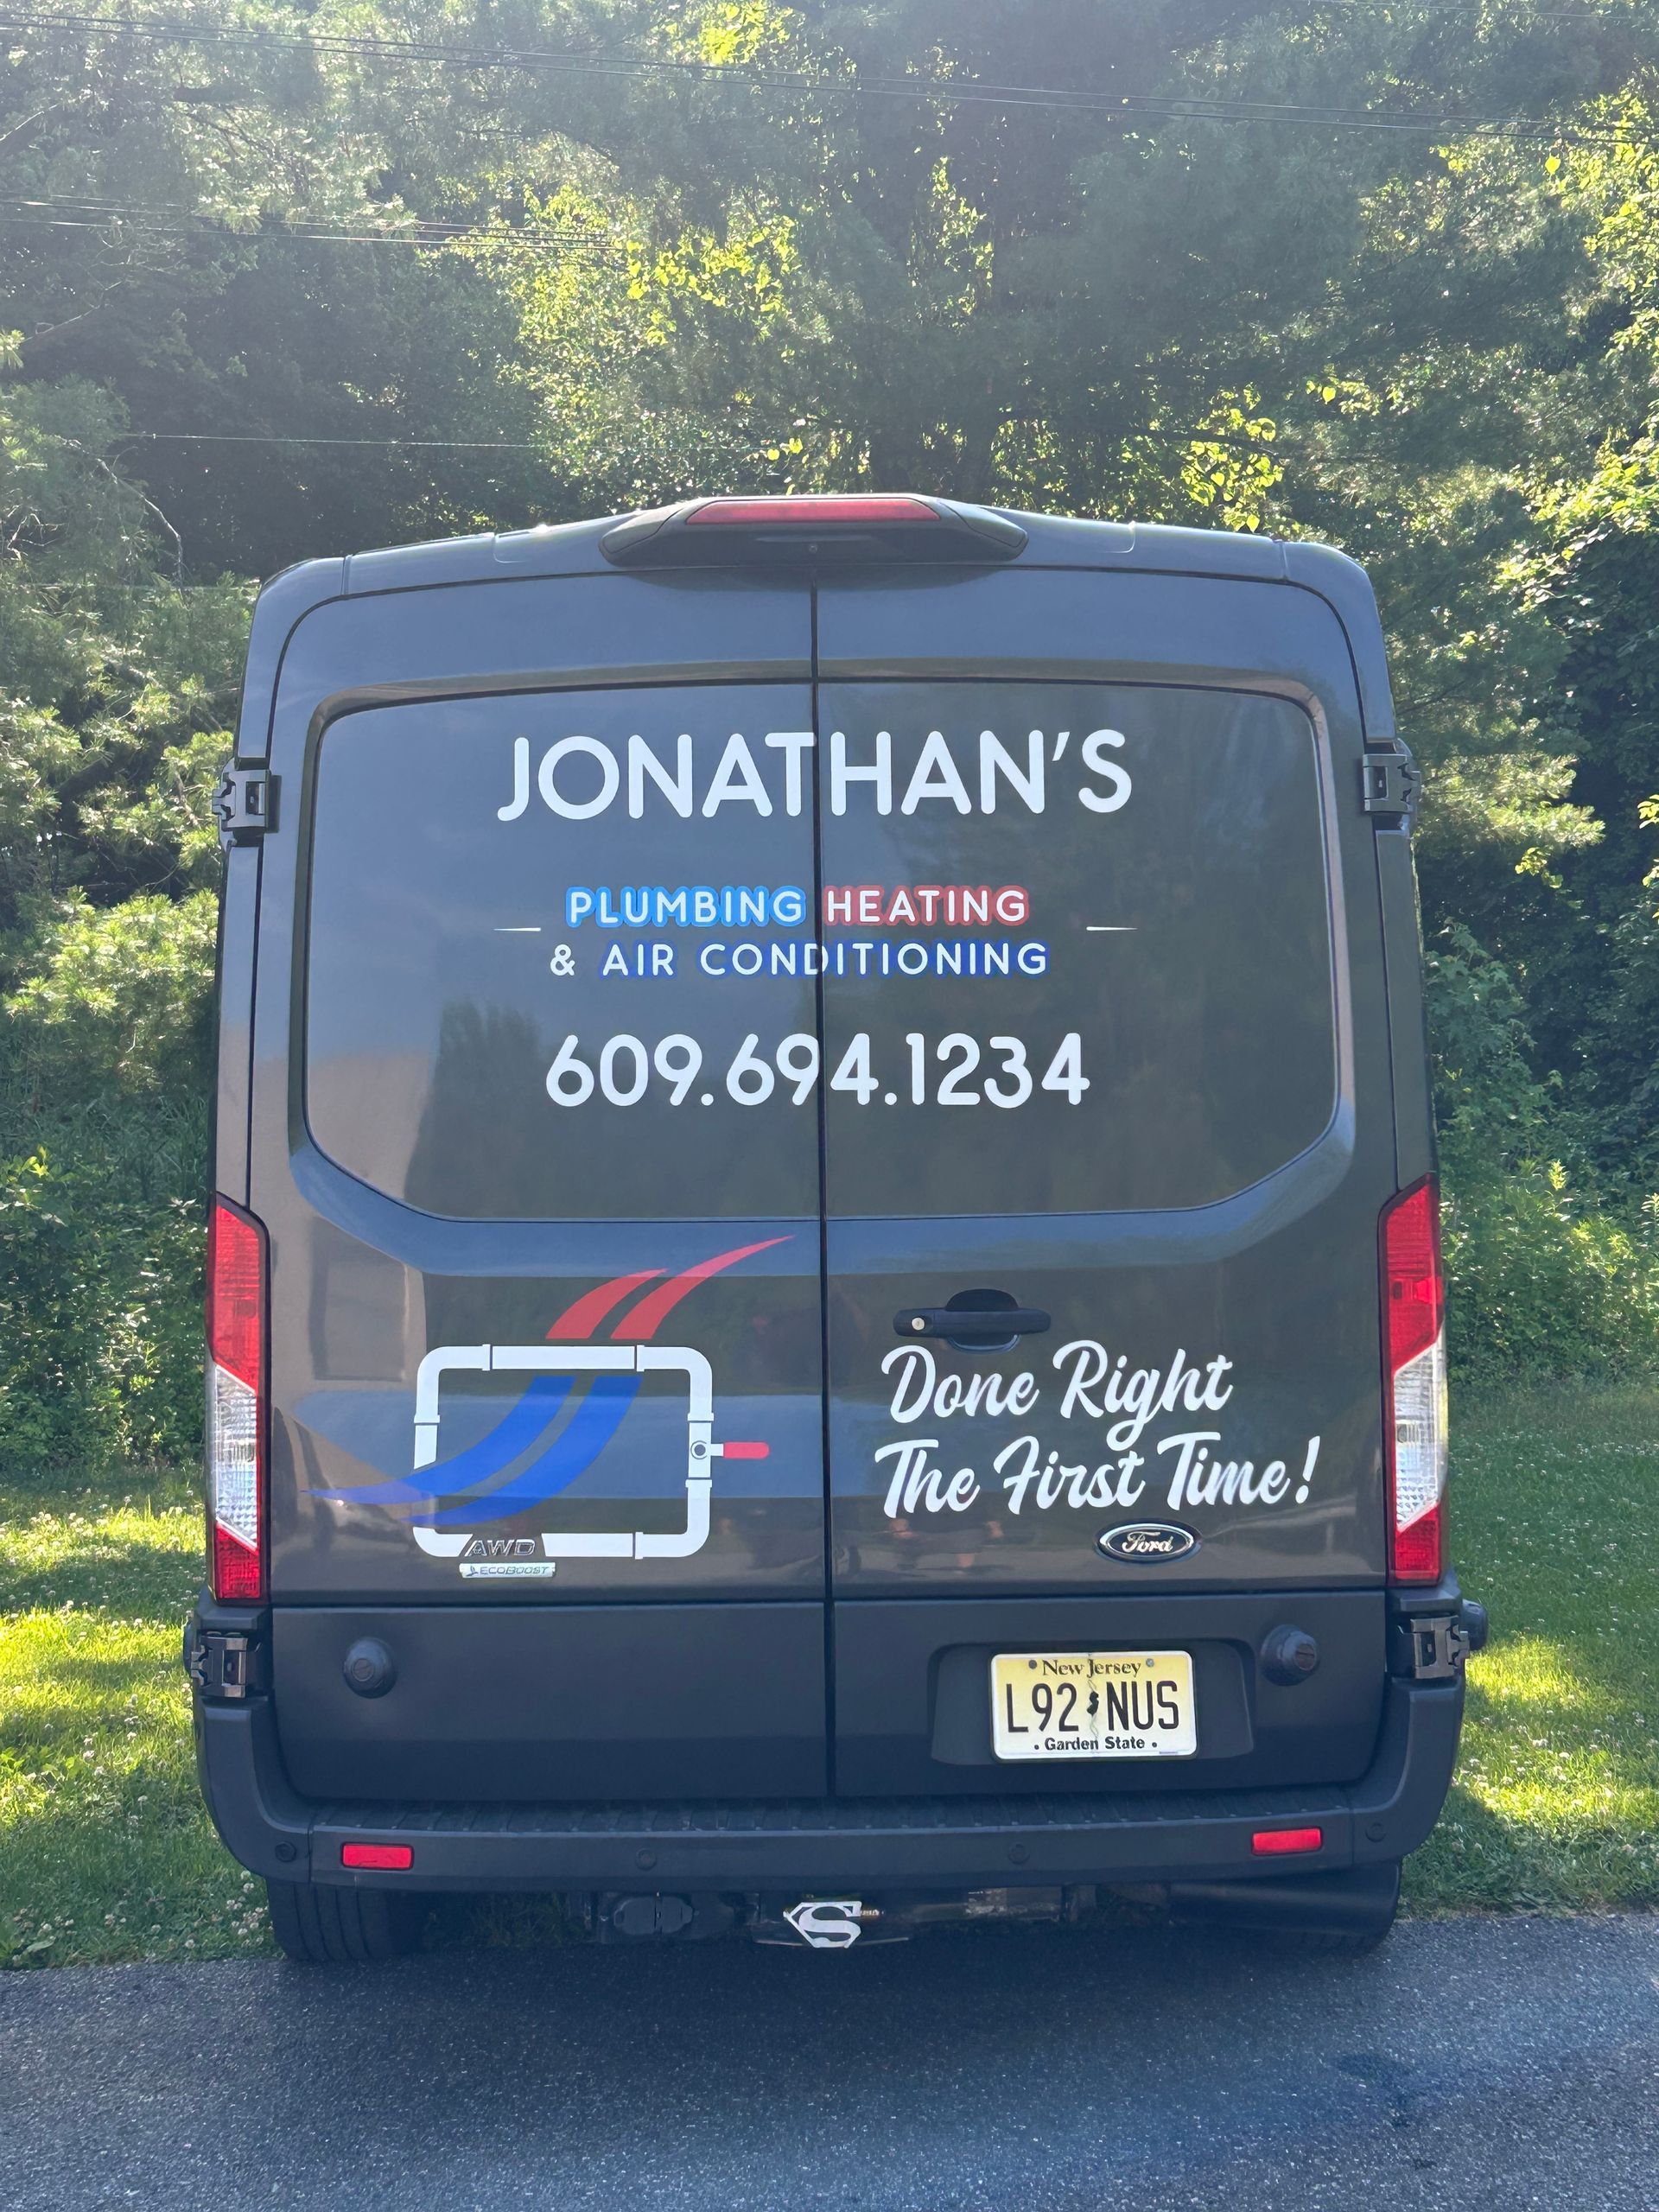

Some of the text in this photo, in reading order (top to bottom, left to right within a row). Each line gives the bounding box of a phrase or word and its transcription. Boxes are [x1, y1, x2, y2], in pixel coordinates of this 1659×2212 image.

[497, 729, 1132, 822] JONATHAN'S
[570, 890, 1026, 924] PLUMBING HEATING
[550, 943, 1047, 976] & AIR CONDITIONING
[546, 1033, 1090, 1108] 609.694.1234
[881, 1340, 1232, 1451] Done Right
[874, 1432, 1320, 1518] The First Time!
[465, 1539, 535, 1556] AWD
[1122, 1531, 1173, 1553] Ford
[1042, 1659, 1141, 1678] New Jersey
[1006, 1680, 1179, 1732] L92 NUS
[1045, 1736, 1145, 1751] Garden State
